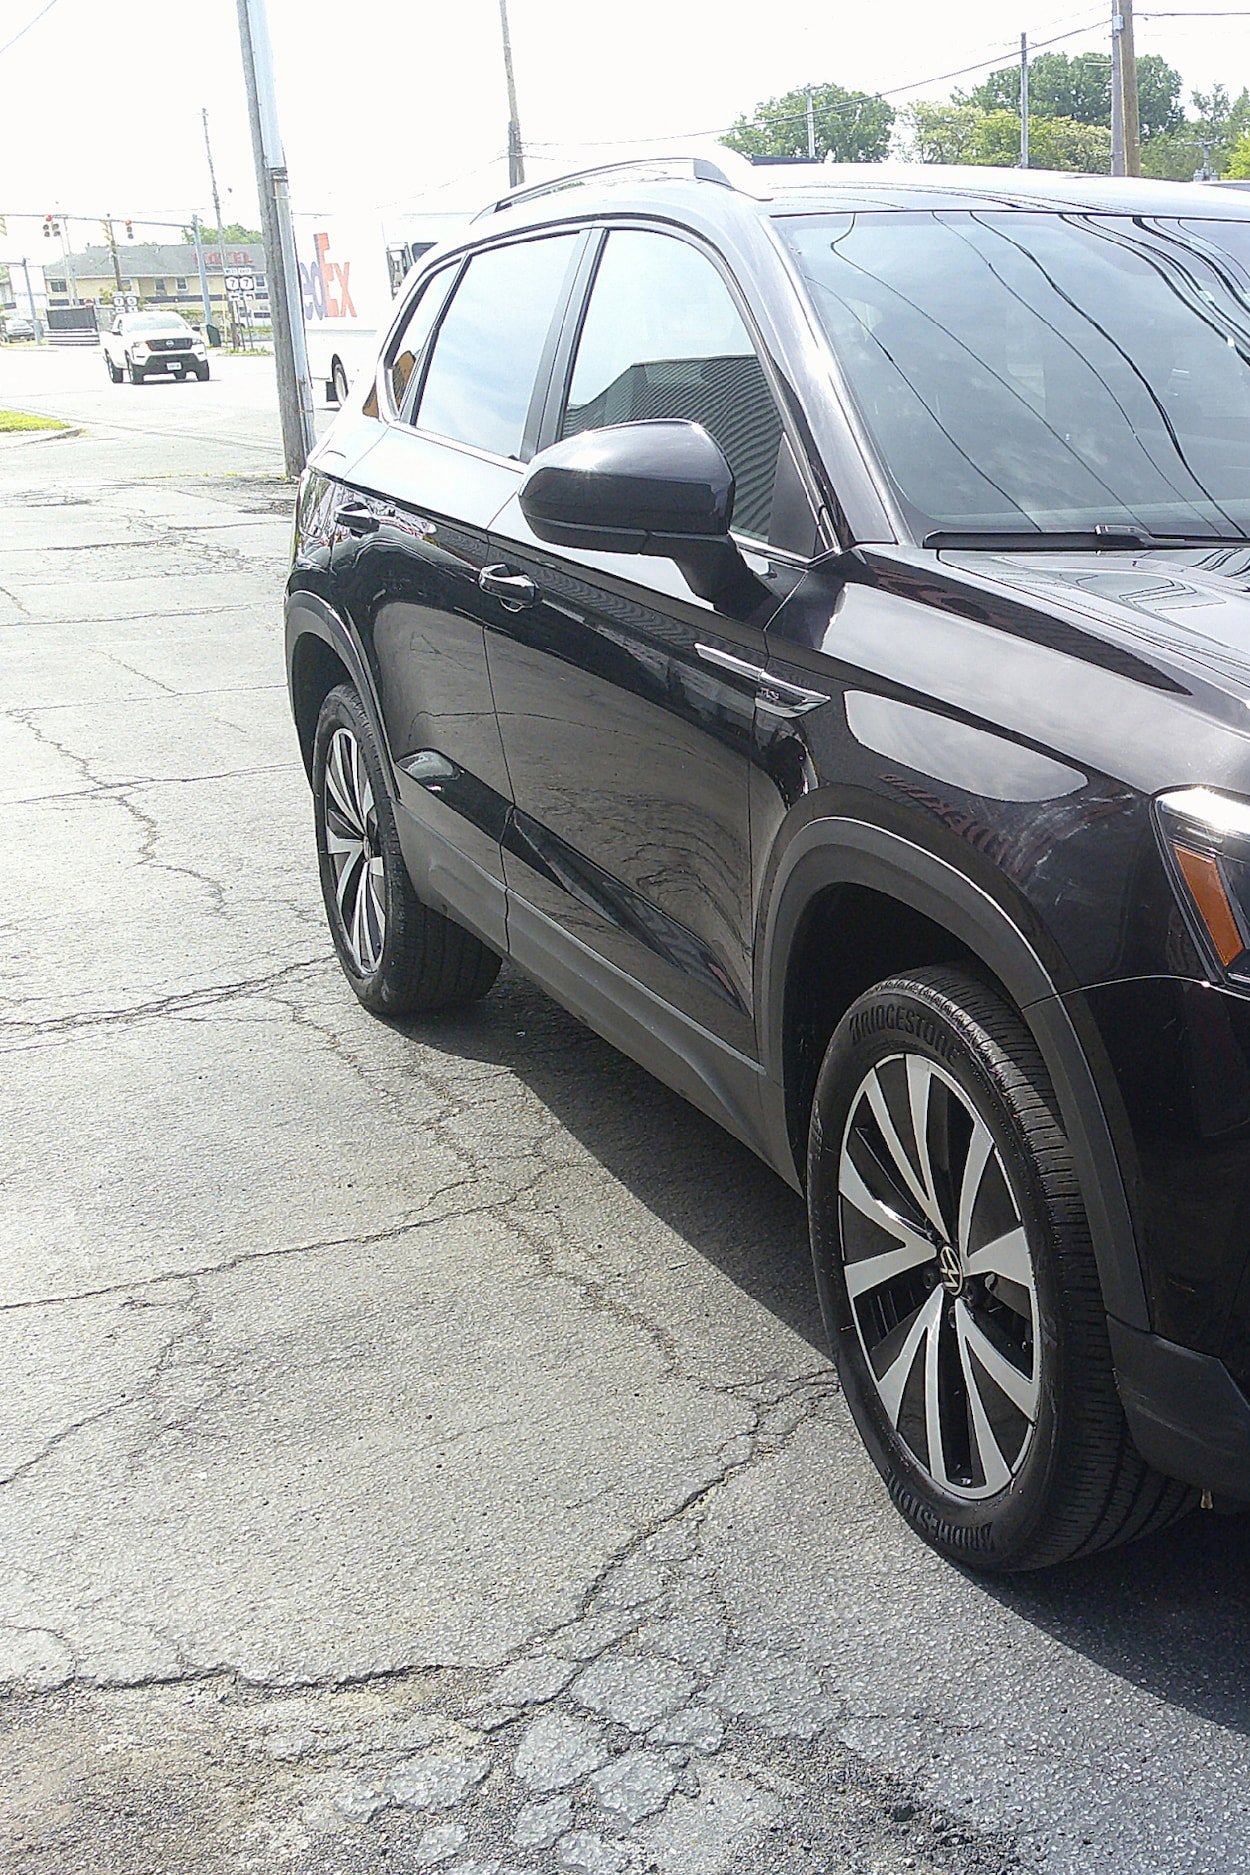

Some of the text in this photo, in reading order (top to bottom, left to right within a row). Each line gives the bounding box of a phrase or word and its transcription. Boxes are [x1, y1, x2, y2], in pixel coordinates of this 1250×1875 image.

[229, 279, 235, 288] 7
[243, 279, 249, 288] 7
[299, 232, 357, 320] edEx
[849, 1004, 954, 1059] BRIDGESTONE
